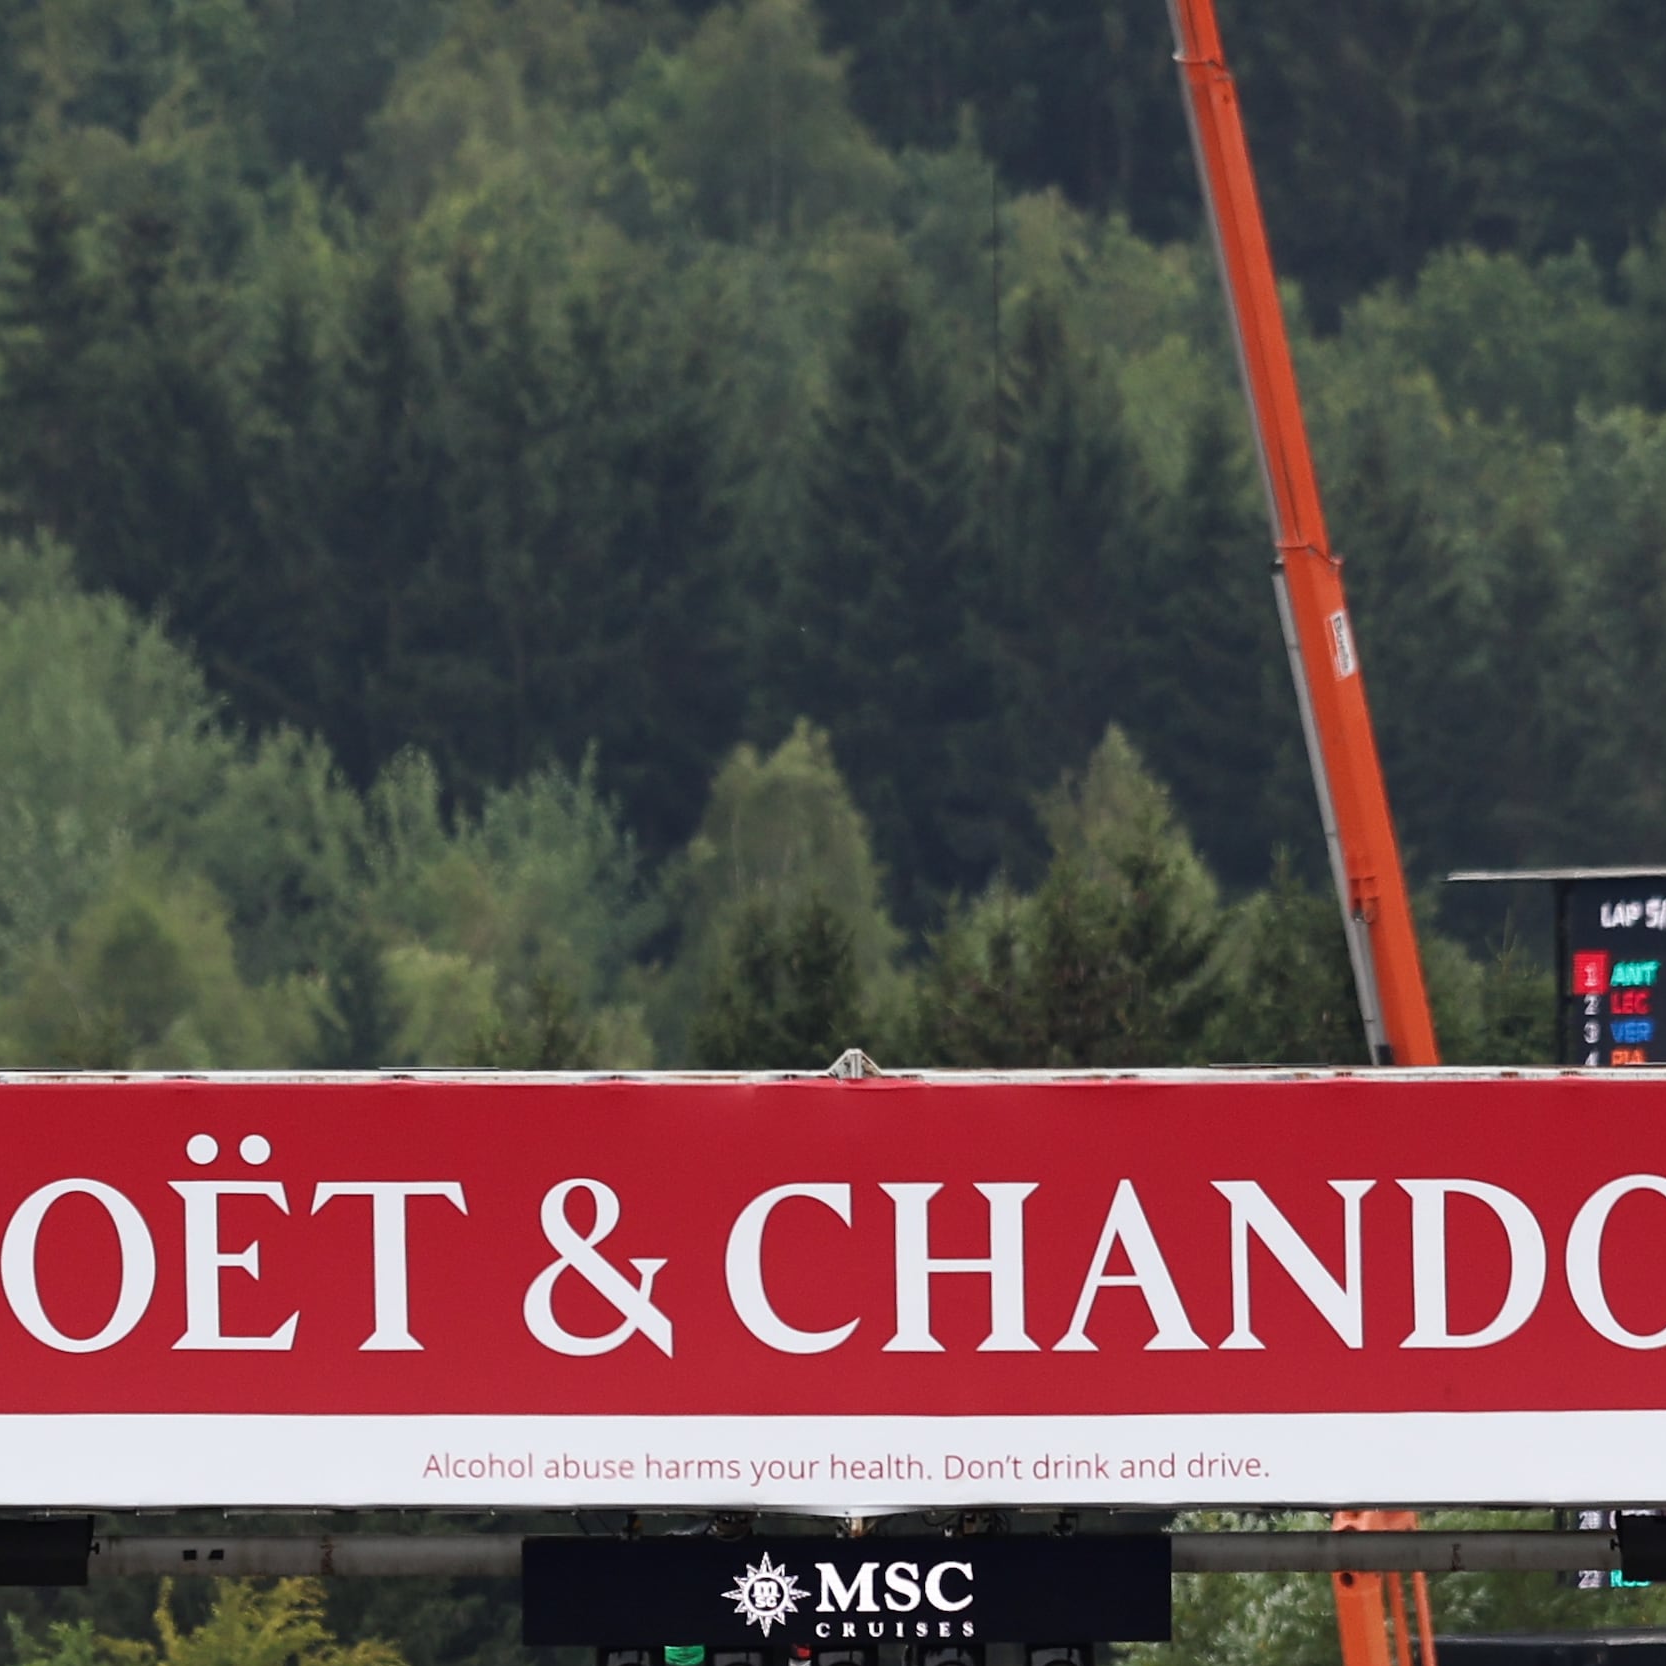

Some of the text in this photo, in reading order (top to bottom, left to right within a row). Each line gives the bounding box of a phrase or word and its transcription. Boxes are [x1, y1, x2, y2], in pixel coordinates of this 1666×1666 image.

[1600, 901, 1642, 928] LAP
[1584, 961, 1661, 987] 1 ANT
[1584, 994, 1599, 1015] 2
[1610, 990, 1651, 1014] LEC
[1584, 1020, 1599, 1043] 3
[1610, 1019, 1654, 1042] VER
[522, 1178, 673, 1358] &
[422, 1452, 1270, 1487] Alcohol abuse harms your health. Don't drink and drive.
[815, 1561, 973, 1612] MSC
[815, 1621, 974, 1638] CRUISES
